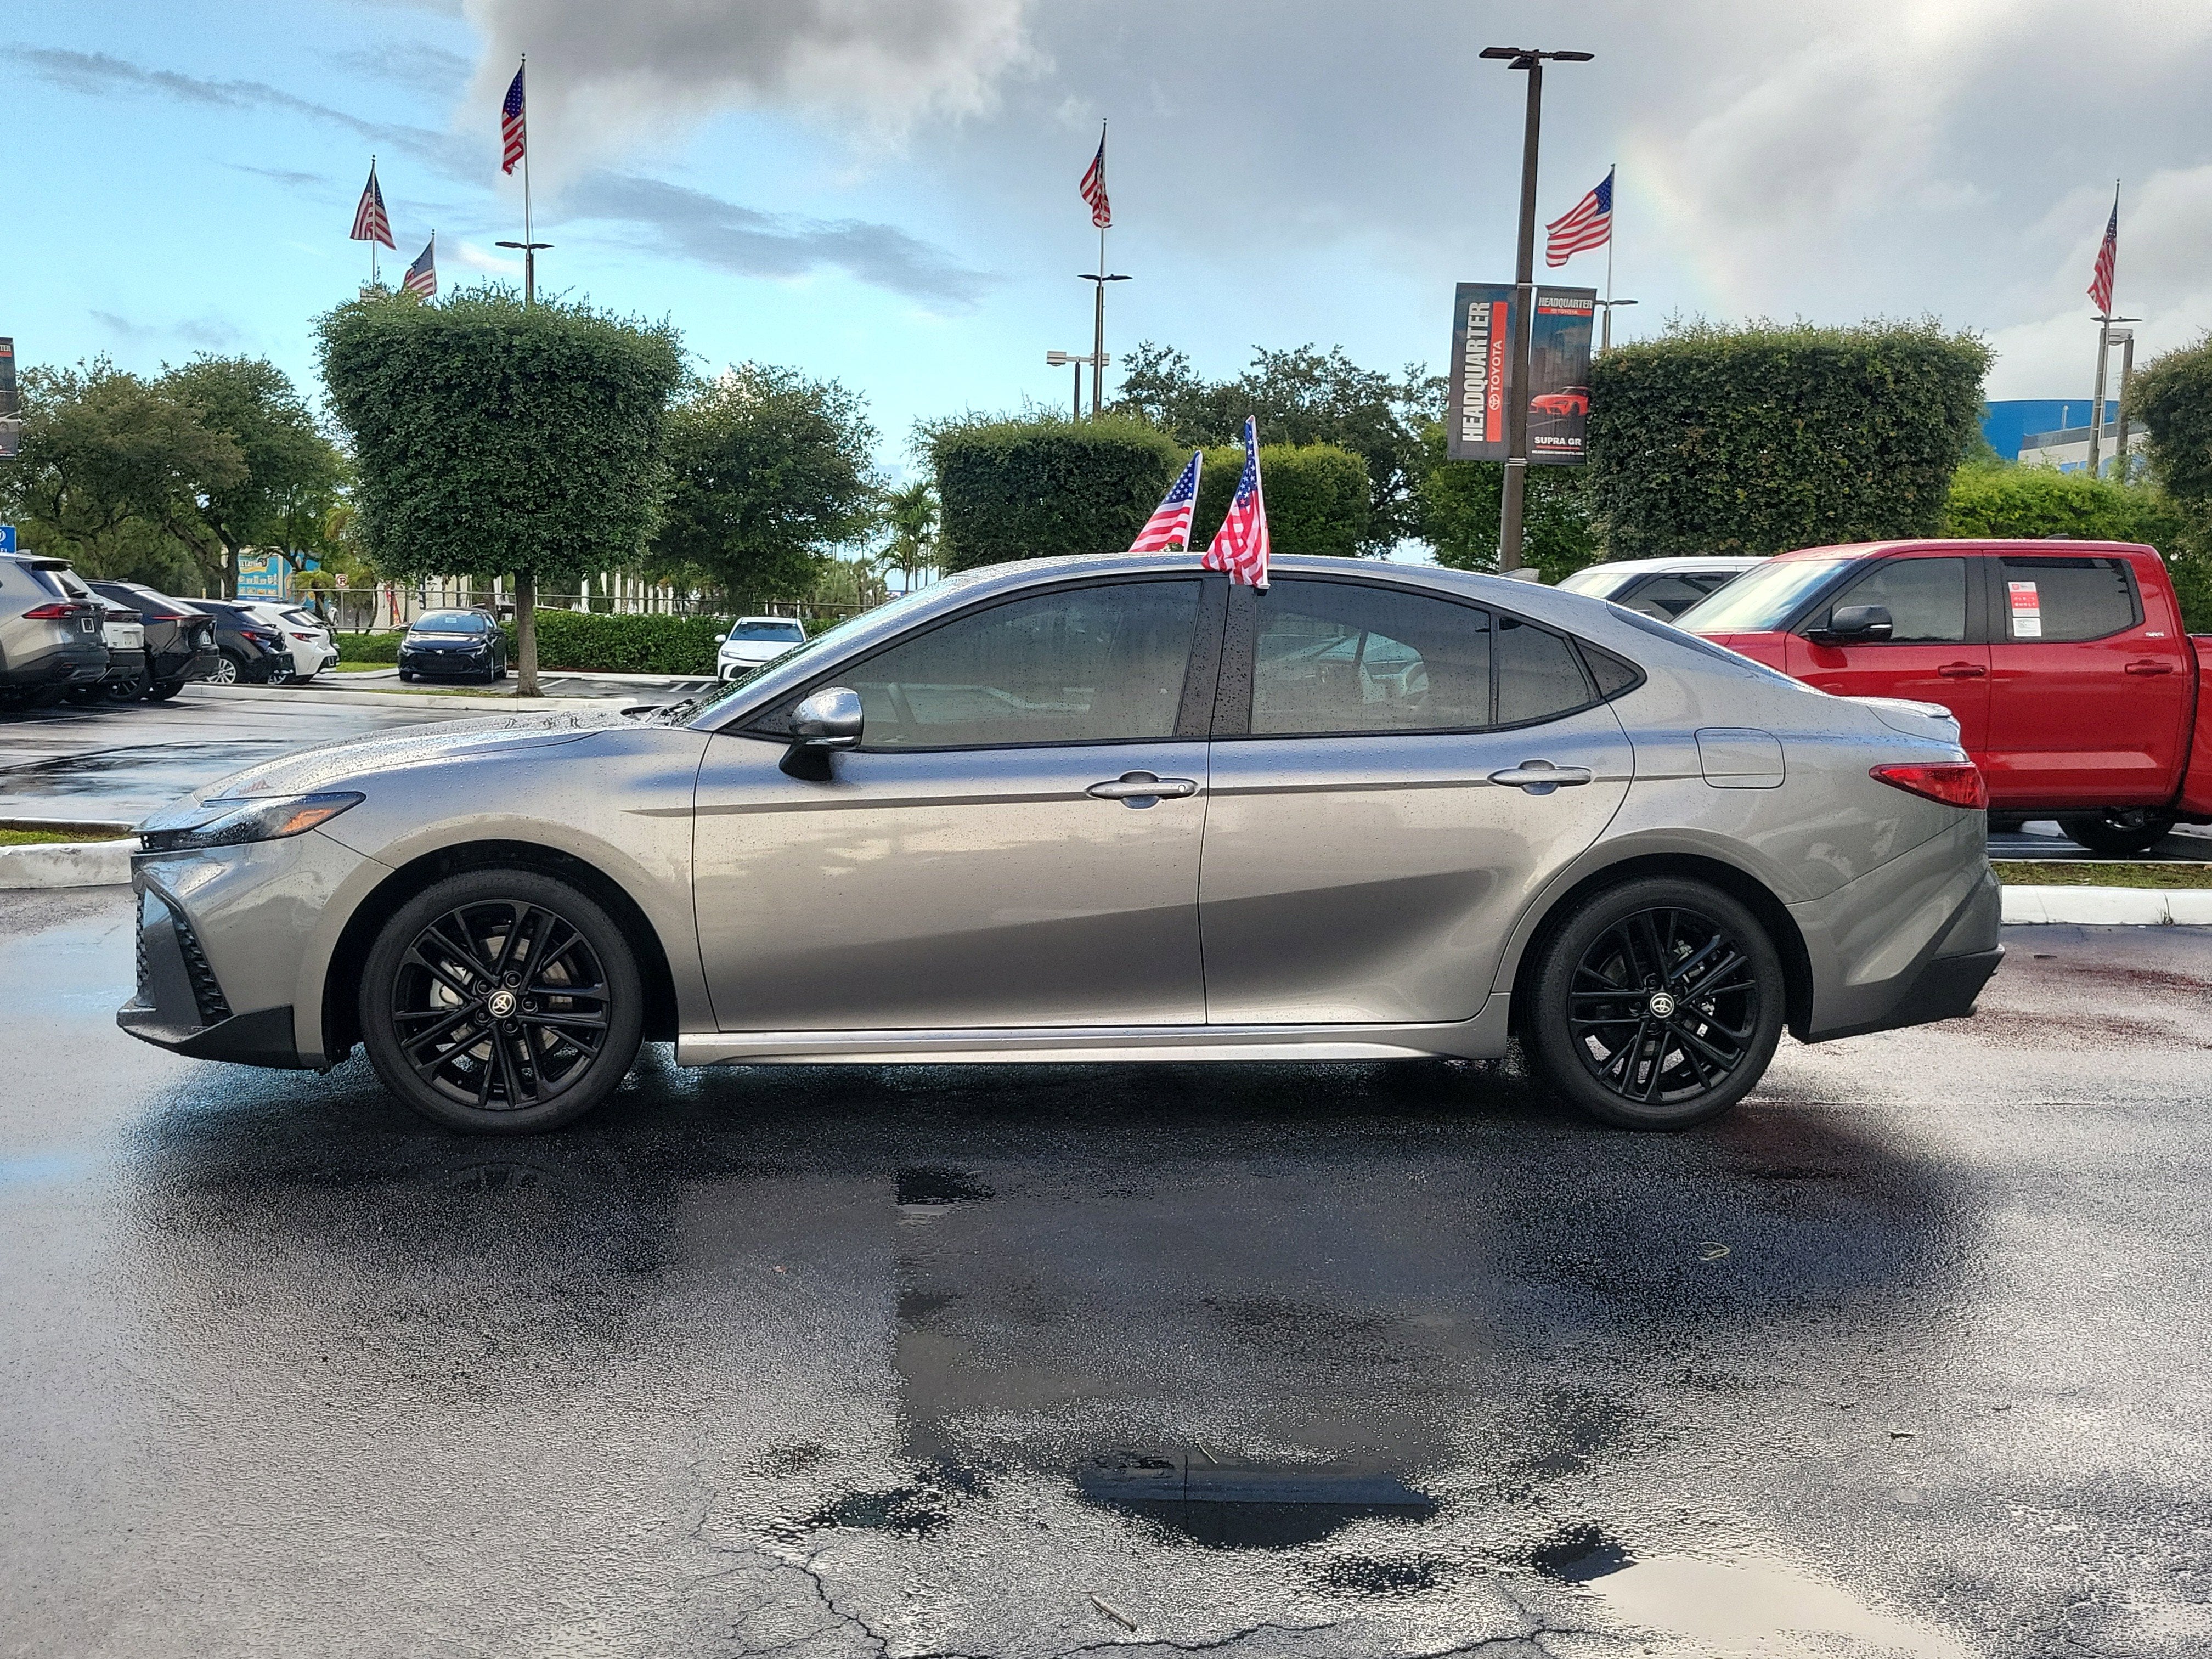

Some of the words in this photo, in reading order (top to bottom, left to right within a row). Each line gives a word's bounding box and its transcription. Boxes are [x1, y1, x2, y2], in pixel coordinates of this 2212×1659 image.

[1538, 297, 1593, 309] HEADQUARTER
[1462, 302, 1490, 441] HEADQUARTER
[1490, 340, 1503, 393] TOYOTA
[1534, 436, 1566, 445] SUPRA
